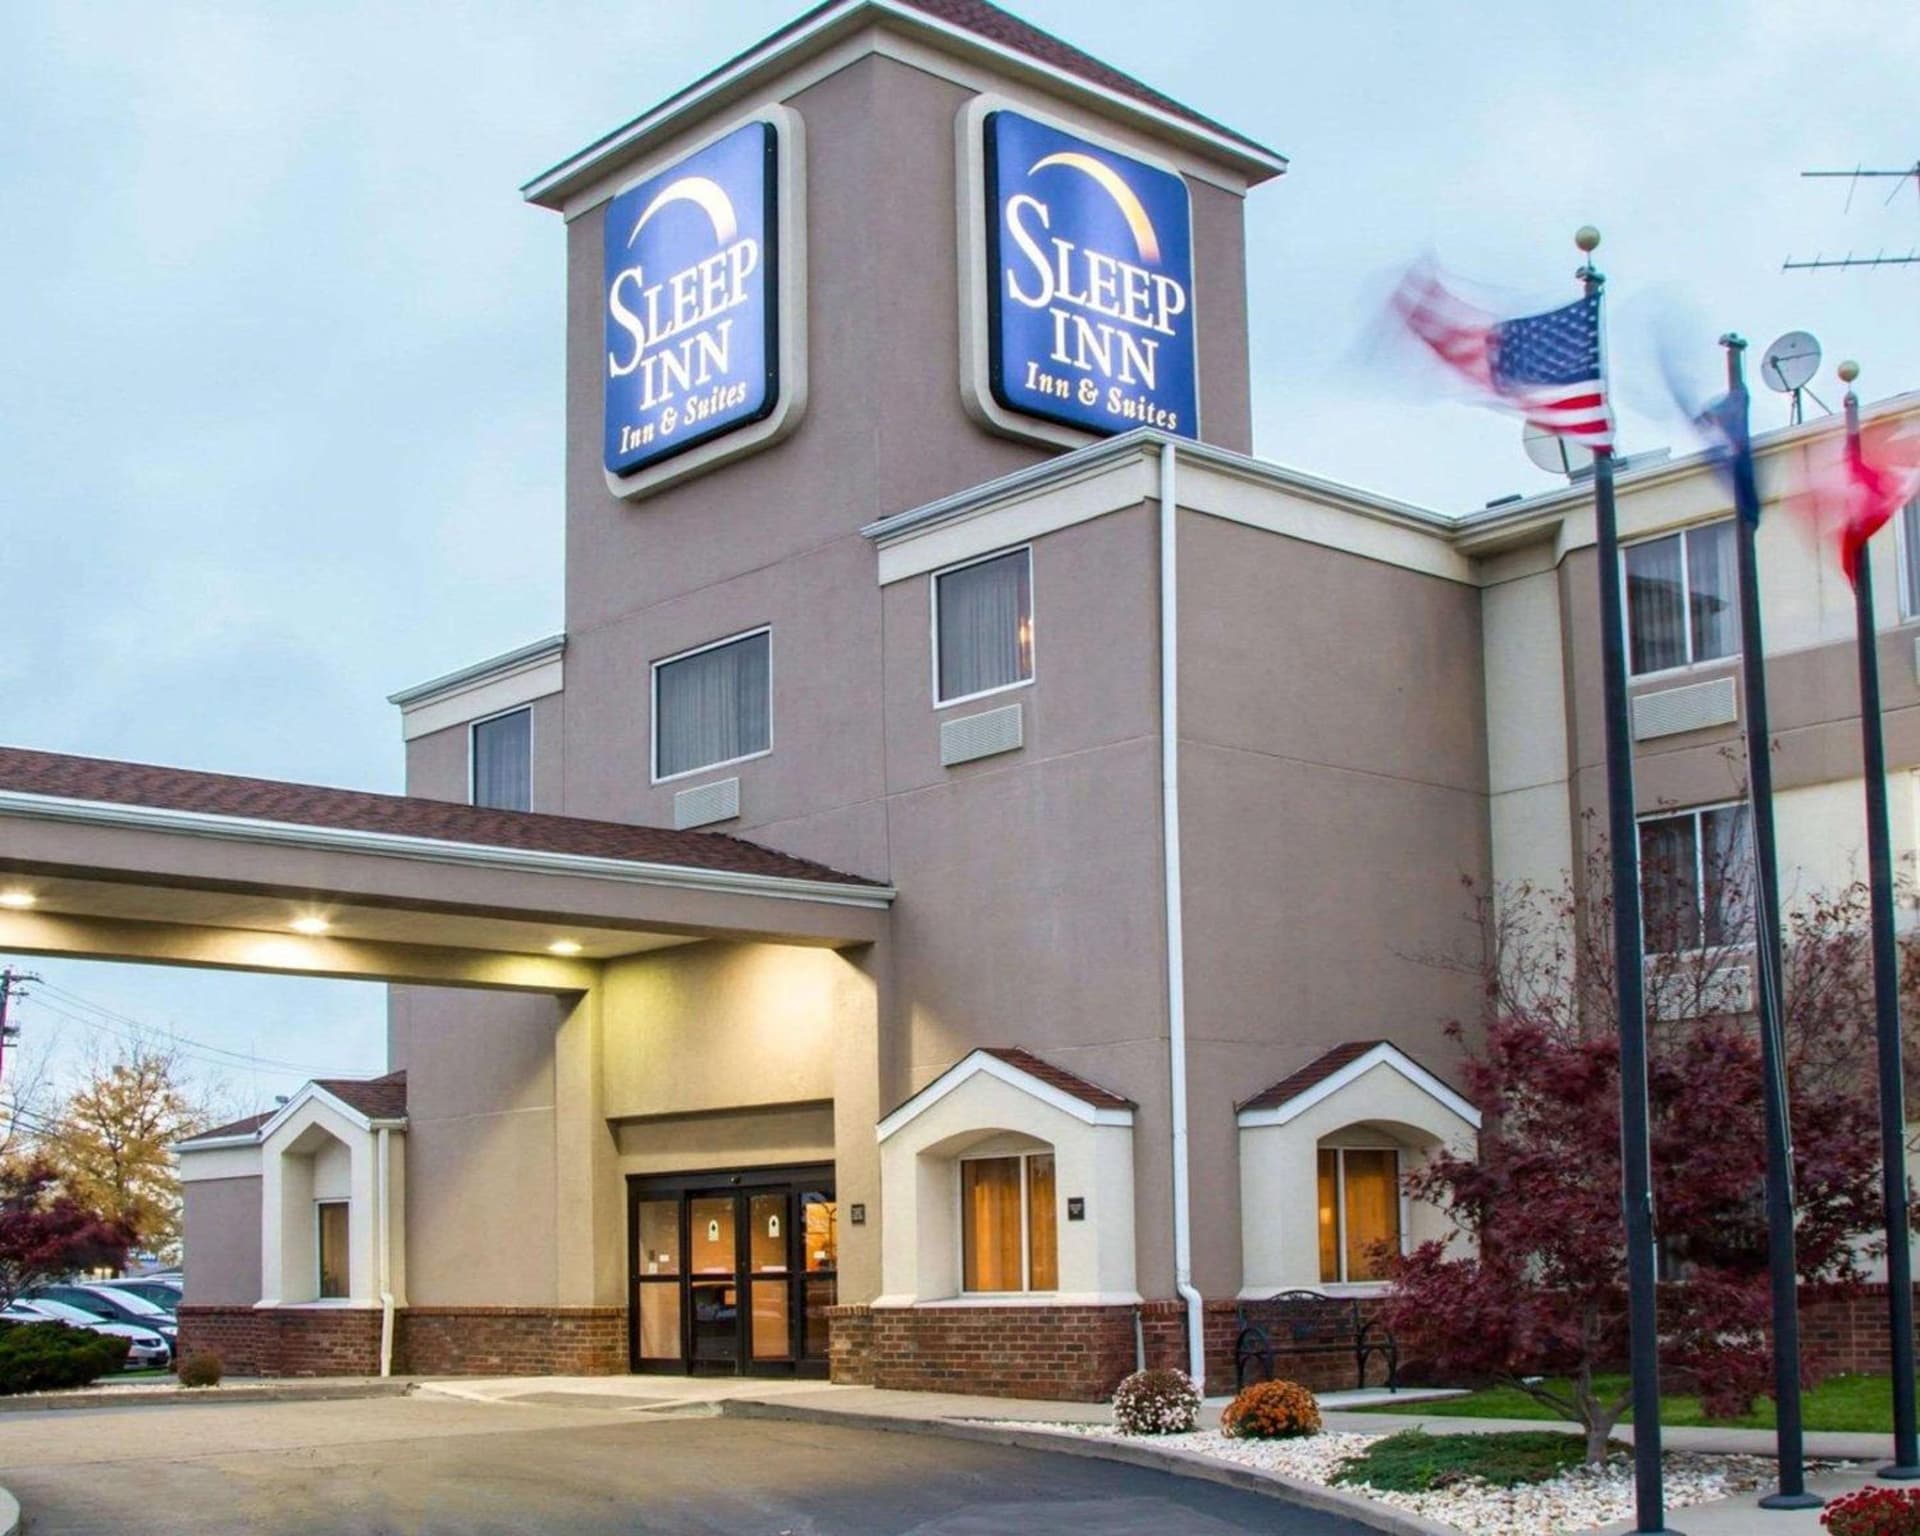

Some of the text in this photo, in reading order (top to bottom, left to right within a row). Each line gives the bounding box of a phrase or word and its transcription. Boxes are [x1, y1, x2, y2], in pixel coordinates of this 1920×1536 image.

[610, 238, 758, 377] SLEEP
[1006, 194, 1186, 336] SLEEP
[640, 320, 732, 410] INN
[1049, 307, 1158, 390] INN
[620, 381, 746, 454] Inn & Suites
[1025, 362, 1177, 430] Inn & Suites
